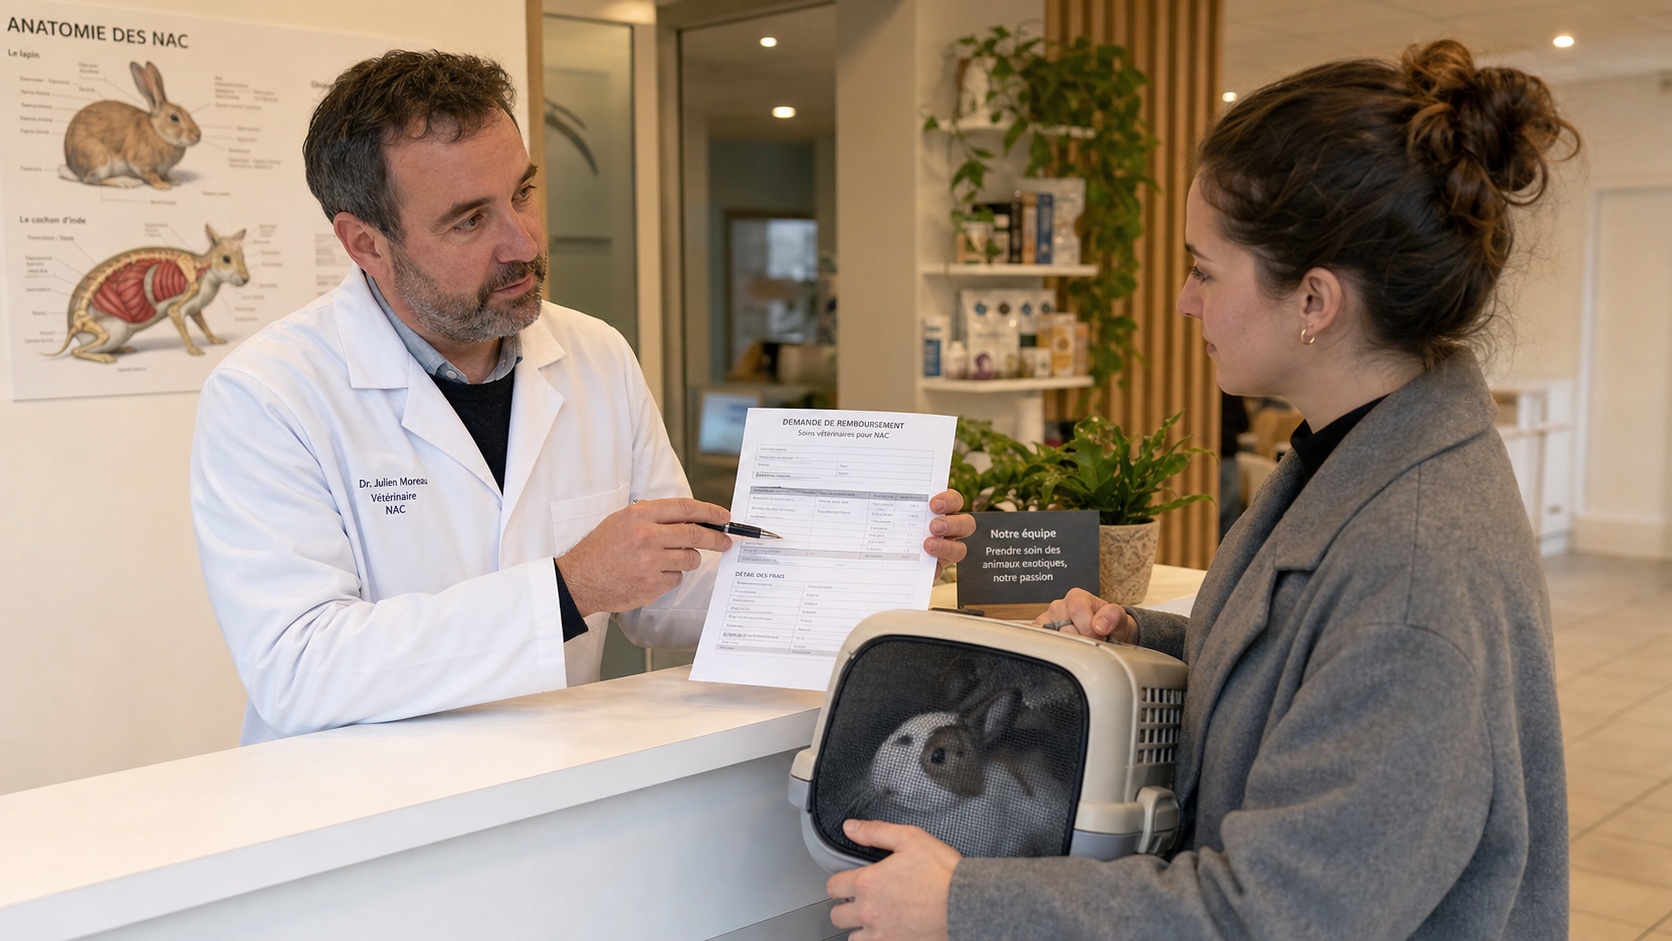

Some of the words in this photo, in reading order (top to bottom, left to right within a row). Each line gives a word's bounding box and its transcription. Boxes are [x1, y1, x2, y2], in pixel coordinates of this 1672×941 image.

[7, 17, 107, 41] ANATOMIE
[112, 27, 147, 45] DES
[152, 32, 189, 49] NAC
[8, 49, 18, 57] Le
[20, 50, 40, 59] lapin
[782, 418, 823, 427] DEMANDE
[824, 419, 835, 427] DE
[836, 420, 905, 430] REMBOURSEMENT
[797, 429, 815, 437] Soins
[359, 479, 373, 488] Dr.
[374, 478, 398, 488] Julien
[371, 492, 417, 502] Vétérinaire
[386, 505, 406, 515] NAC
[990, 529, 1020, 539] Notre
[1021, 528, 1057, 540] équipe
[985, 546, 1022, 556] Prendre
[1023, 546, 1043, 555] soin
[1044, 545, 1061, 555] des
[982, 560, 1020, 569] animaux
[993, 574, 1018, 582] notre
[1019, 572, 1053, 584] passion
